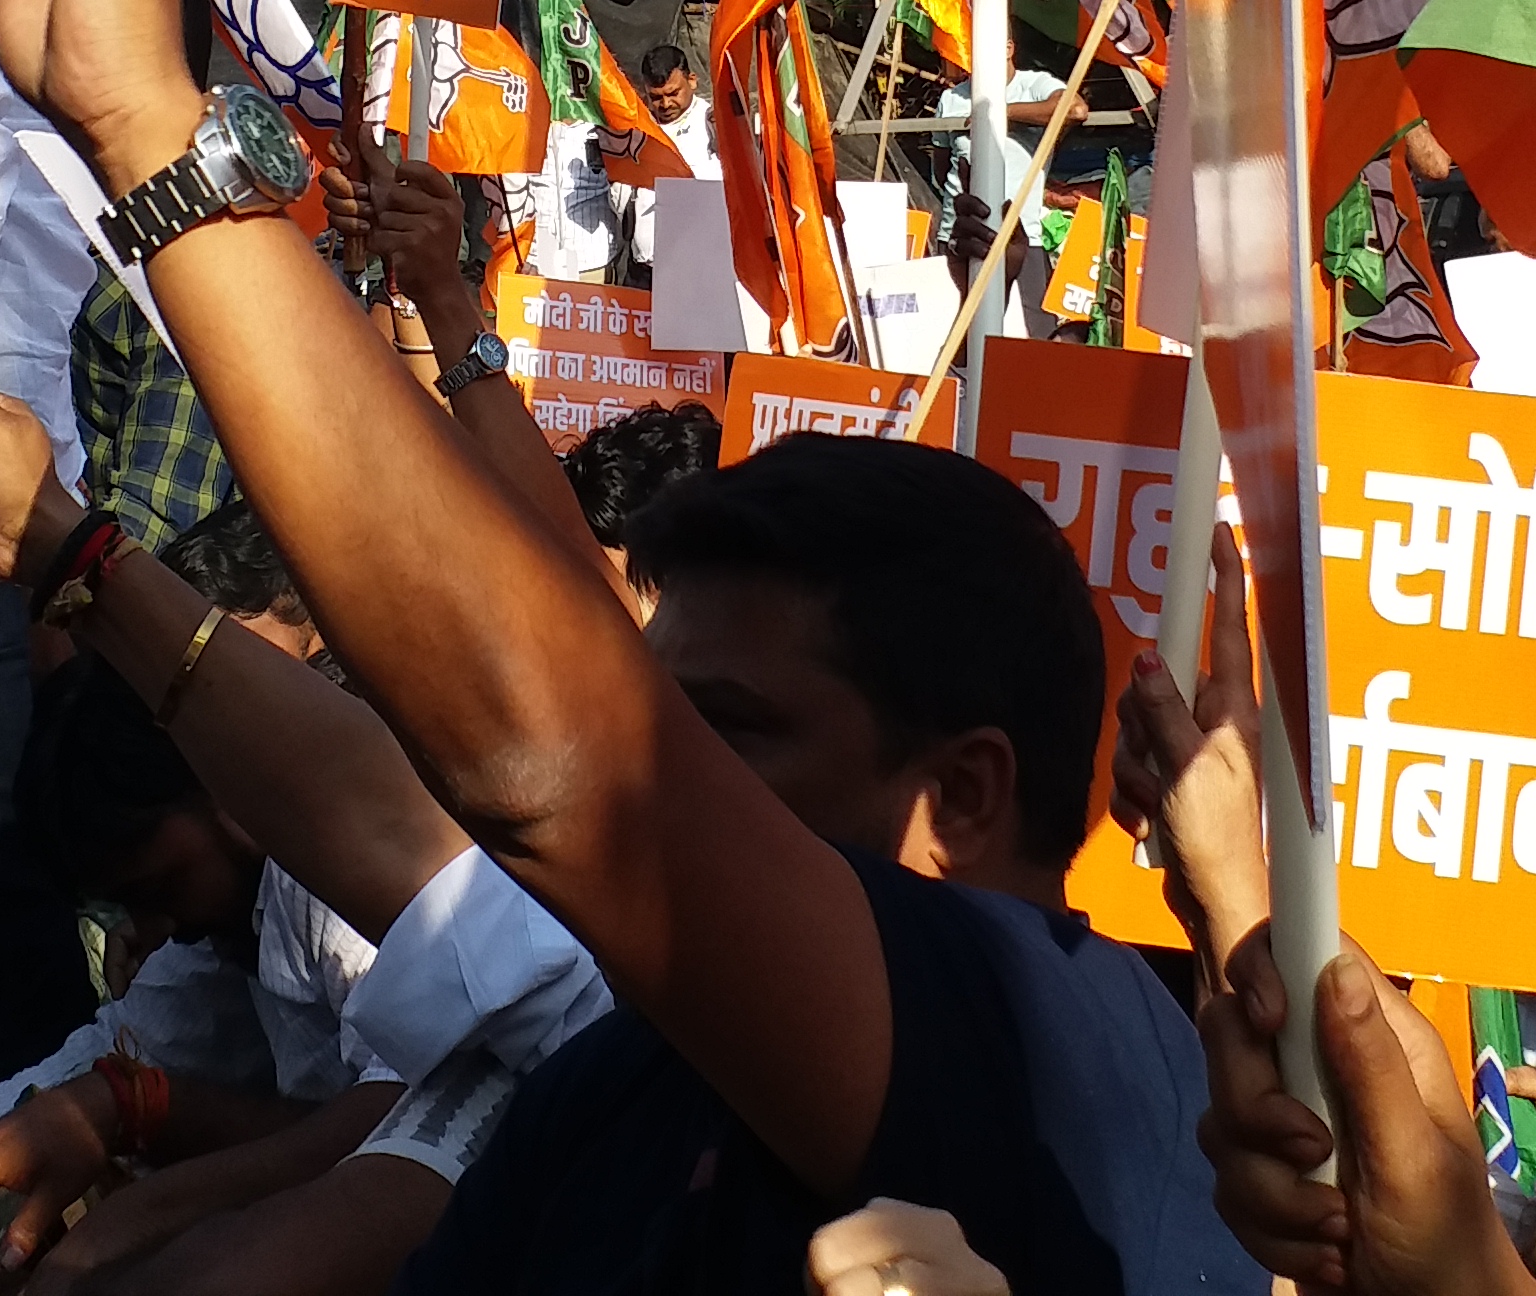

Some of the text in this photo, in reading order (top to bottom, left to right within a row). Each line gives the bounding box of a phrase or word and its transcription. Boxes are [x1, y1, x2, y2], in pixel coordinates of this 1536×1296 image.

[522, 290, 574, 331] मोदी
[575, 295, 605, 334] जी
[606, 298, 630, 336] के
[508, 338, 717, 394] पिता का अपमान नहीं
[532, 393, 594, 434] सहेगा
